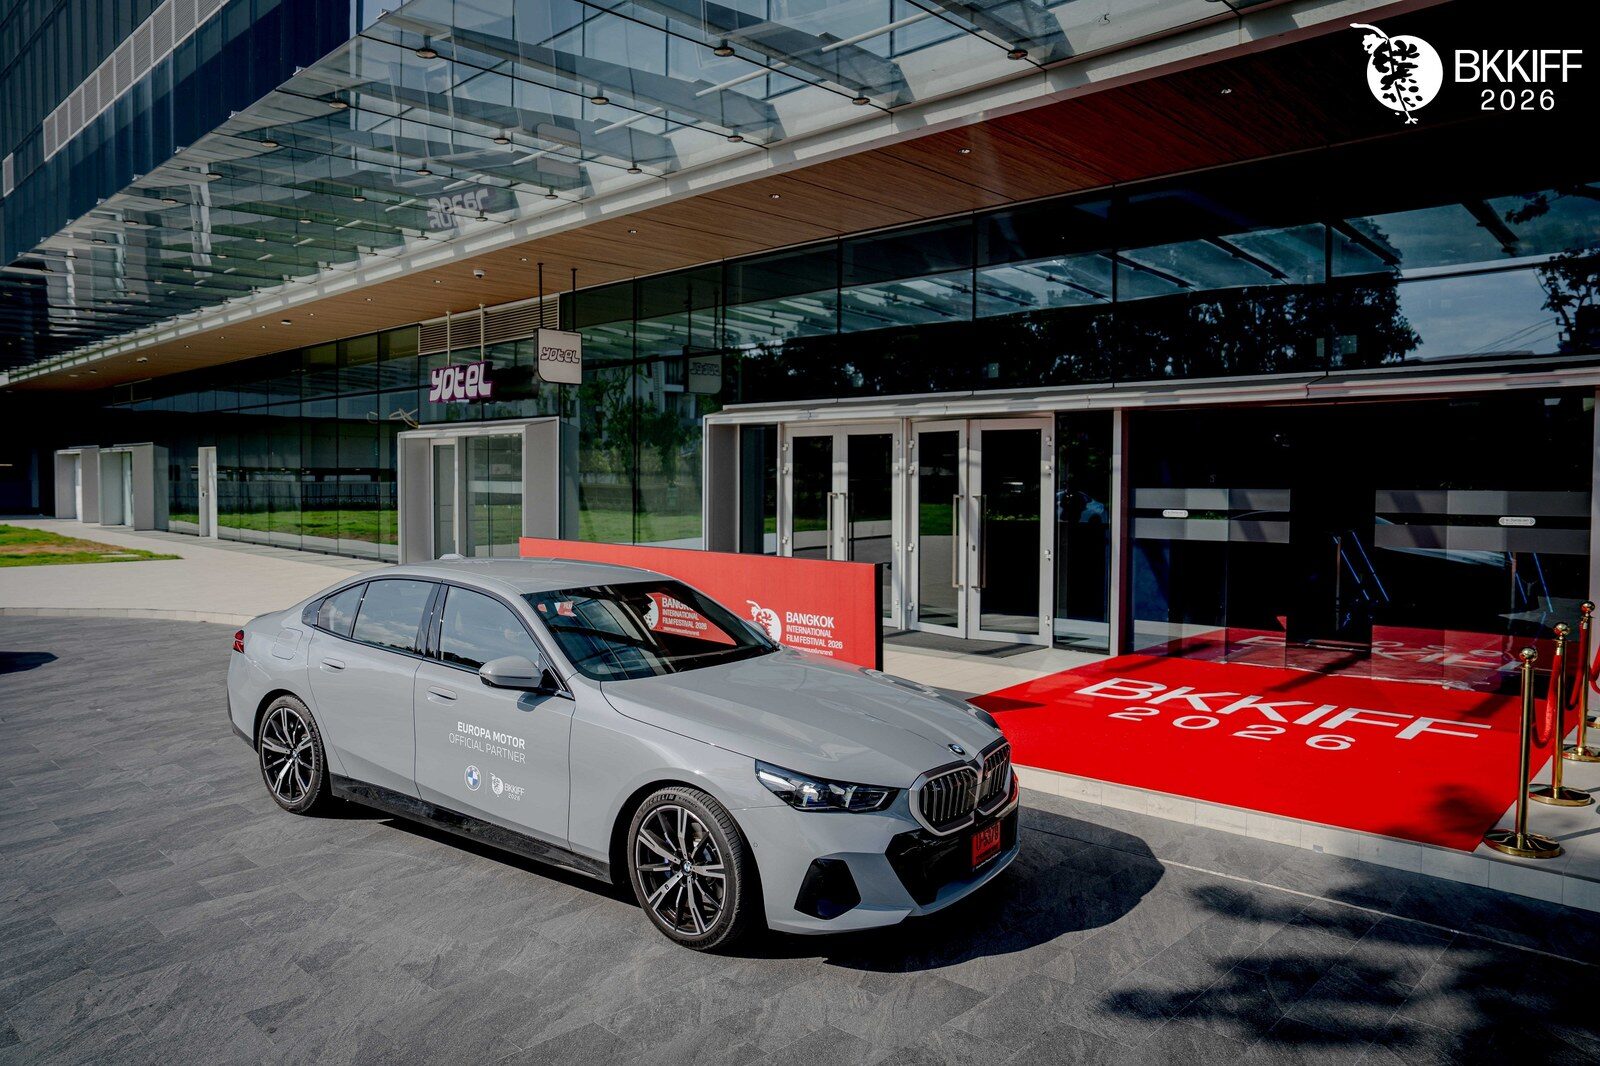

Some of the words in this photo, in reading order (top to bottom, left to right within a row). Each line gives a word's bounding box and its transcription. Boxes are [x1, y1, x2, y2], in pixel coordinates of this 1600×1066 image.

[785, 611, 835, 629] BANGKOK
[785, 624, 833, 639] INTERNATIONAL
[785, 634, 799, 644] FILM
[799, 636, 827, 647] FESTIVAL
[827, 640, 843, 650] 2026
[1074, 677, 1492, 740] BKKIFF
[457, 721, 491, 740] EUROPA
[492, 731, 526, 750] MOTOR
[1108, 706, 1356, 751] 2026
[448, 732, 485, 753] OFFICIAL
[485, 743, 526, 764] PARTNER
[504, 782, 525, 796] BKKIFF
